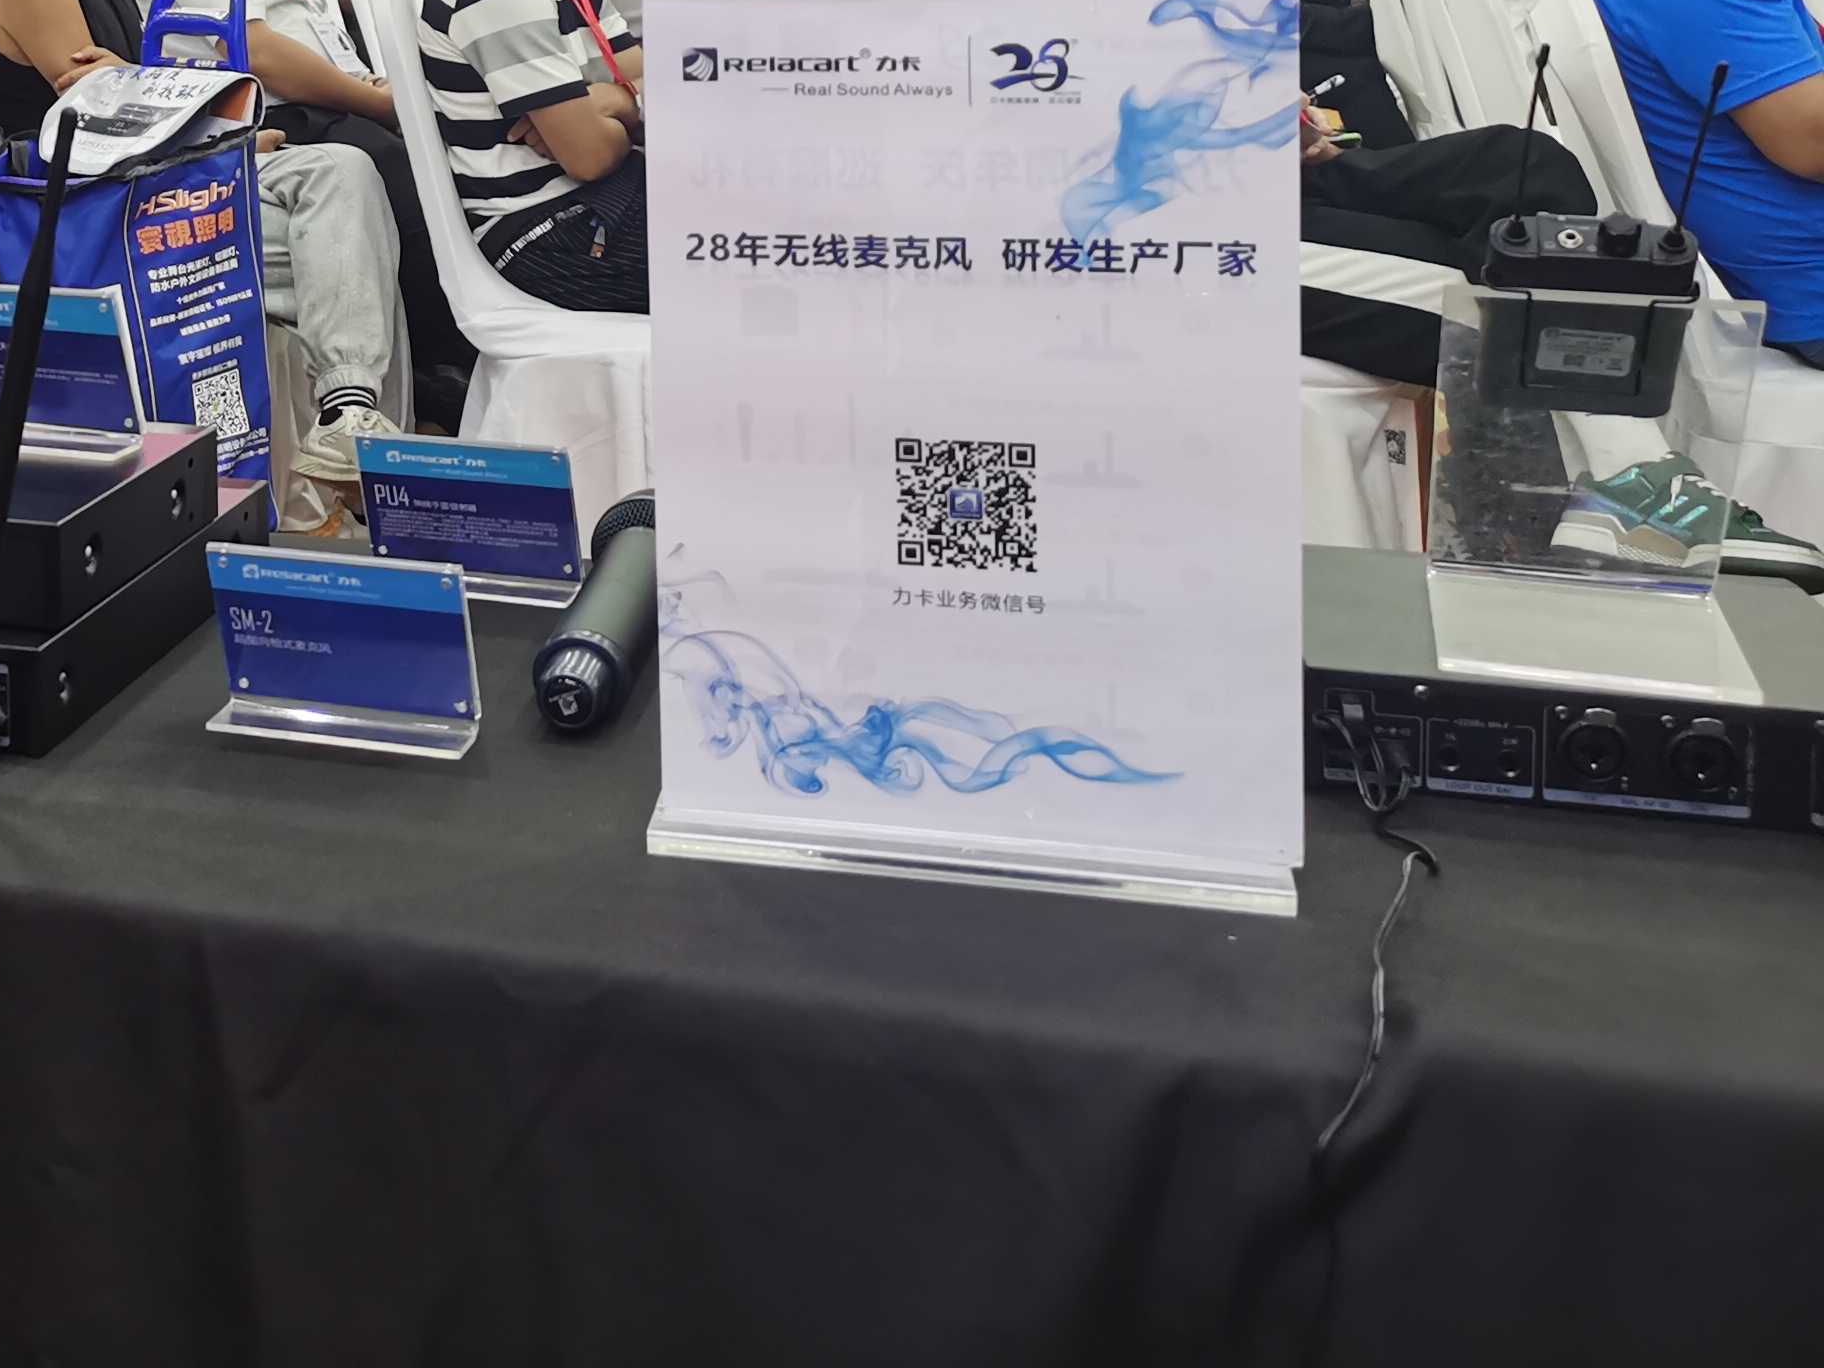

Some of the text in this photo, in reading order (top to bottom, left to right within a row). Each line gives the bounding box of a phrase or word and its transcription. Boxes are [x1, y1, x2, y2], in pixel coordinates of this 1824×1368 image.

[724, 55, 921, 73] Relacart 力卡
[794, 83, 953, 98] Real Sound Always
[685, 231, 1258, 278] 28年无线麦克风 研发生产厂家
[373, 483, 410, 507] PU4
[891, 586, 1047, 616] 力卡业务微信号
[229, 605, 275, 634] SM-2
